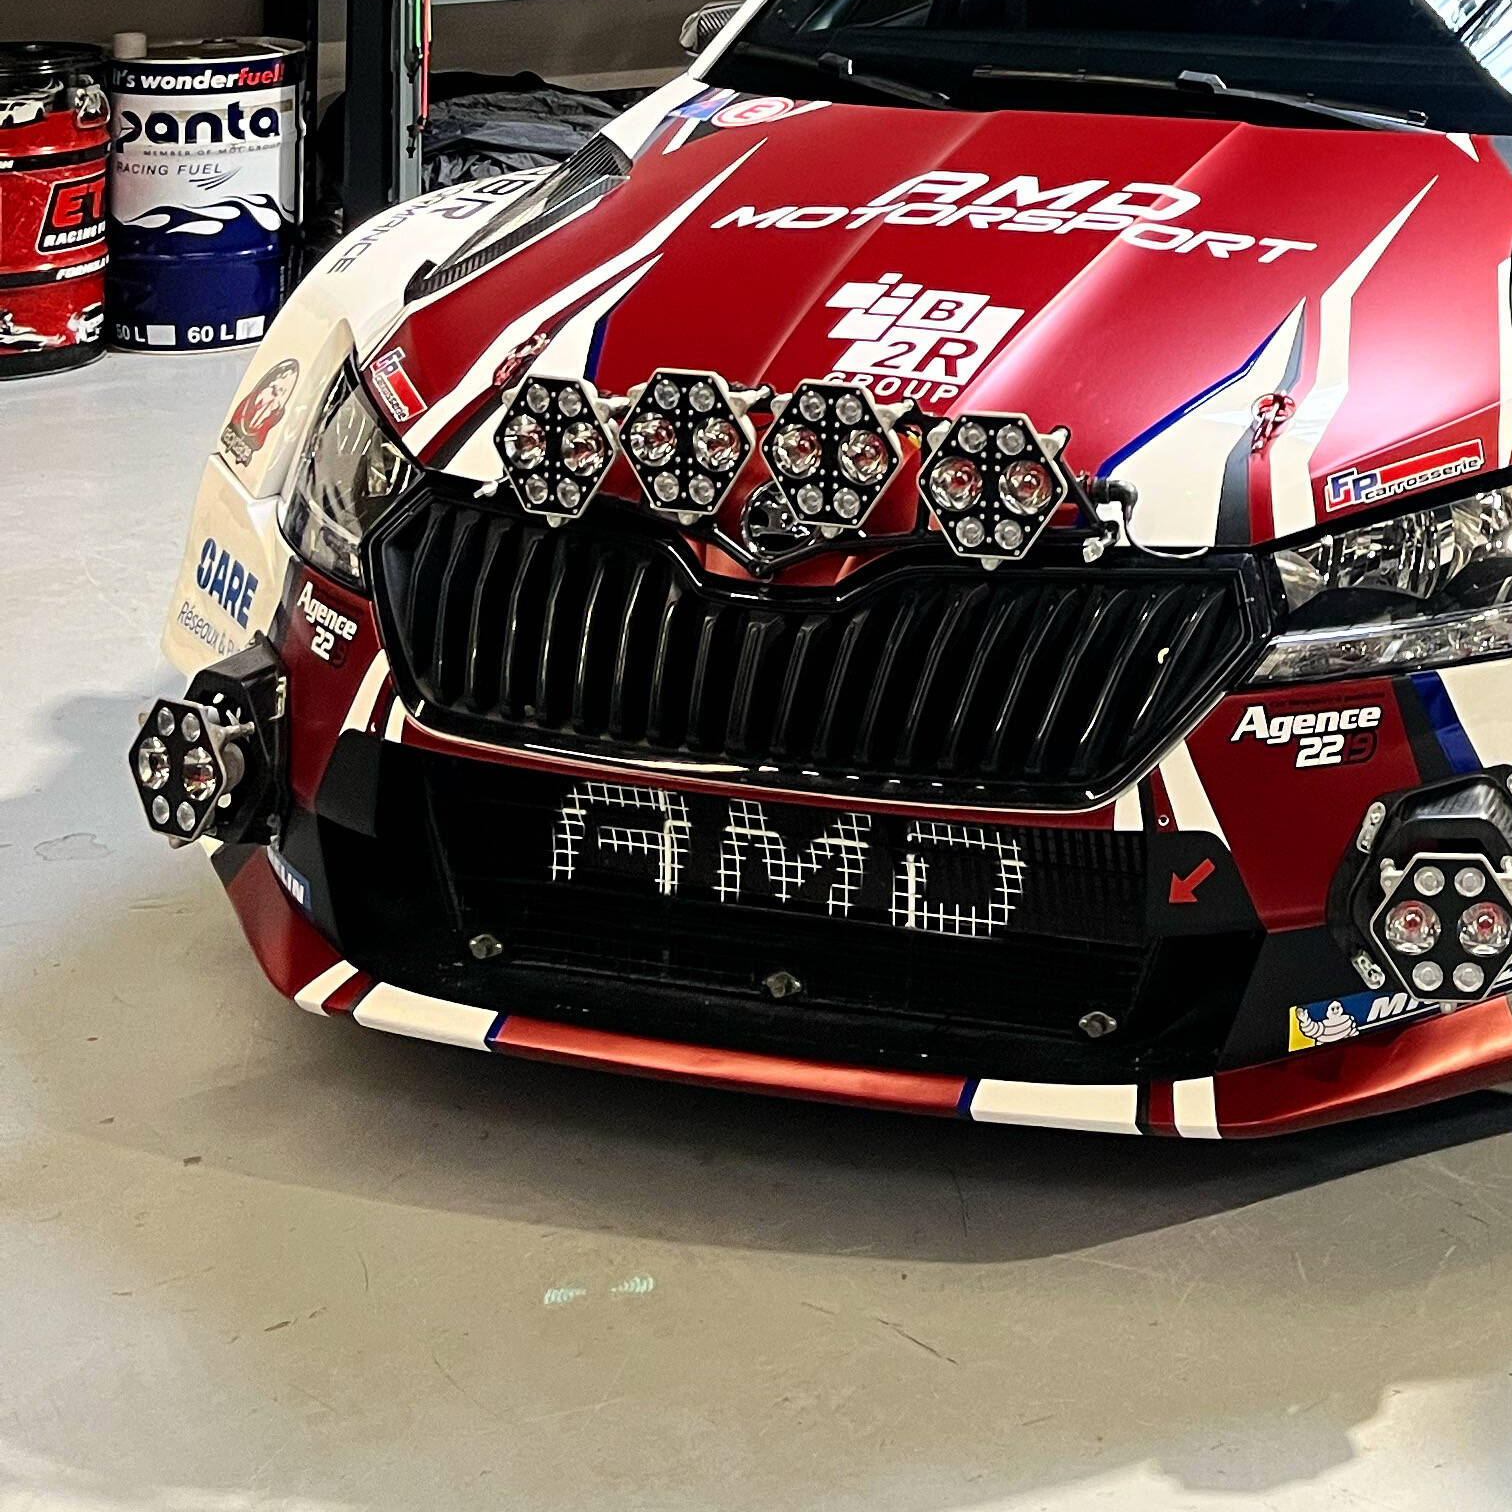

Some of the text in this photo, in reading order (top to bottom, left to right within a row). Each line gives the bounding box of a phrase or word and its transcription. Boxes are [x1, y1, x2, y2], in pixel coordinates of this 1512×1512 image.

[140, 63, 285, 90] wonderfuel!
[116, 100, 281, 154] panta
[116, 161, 223, 177] RACING FUEL
[865, 169, 1203, 221] AMD
[710, 201, 1318, 265] MOTORSPORT
[920, 298, 965, 322] B
[134, 326, 147, 343] L
[186, 323, 235, 344] 60 L
[1330, 469, 1378, 501] FP
[1364, 457, 1479, 500] carrosserie
[296, 580, 358, 641] Agence
[1230, 705, 1382, 745] Agence
[548, 780, 1029, 940] AMD
